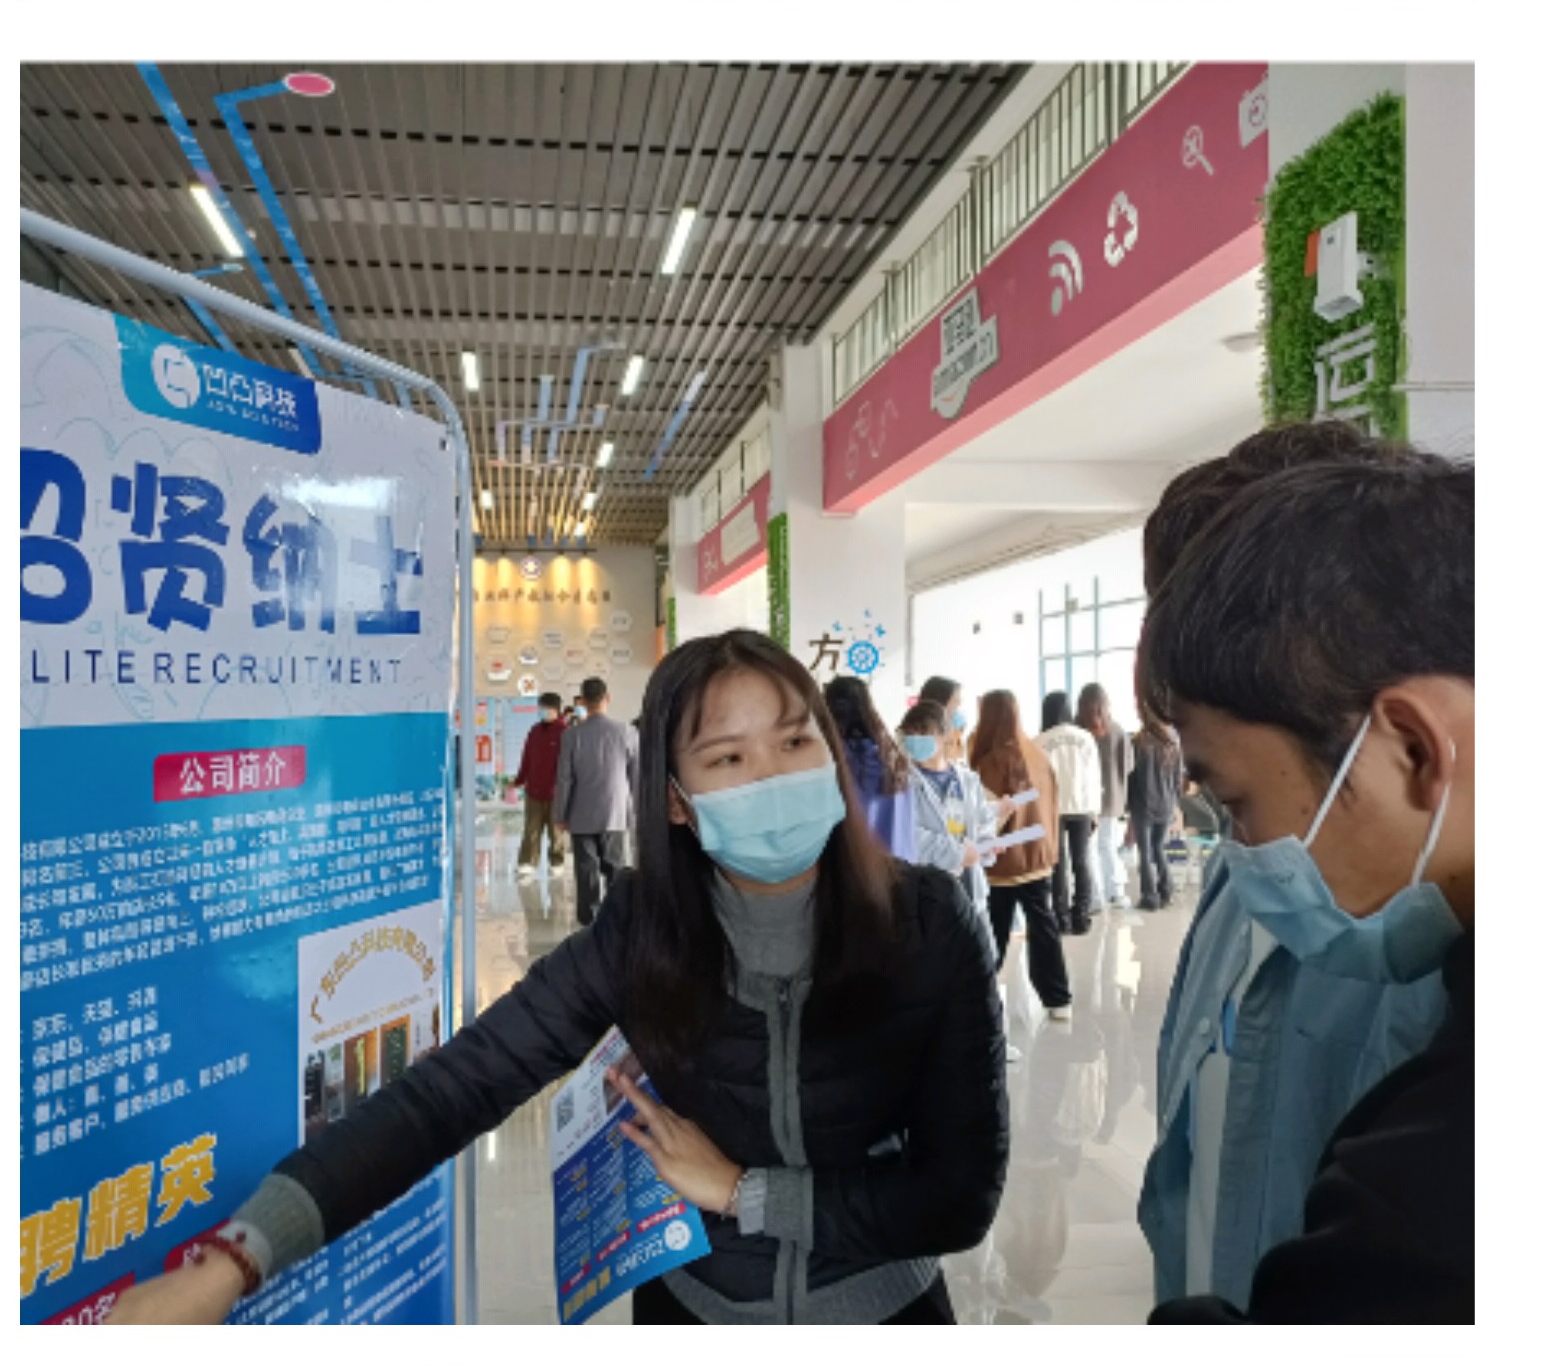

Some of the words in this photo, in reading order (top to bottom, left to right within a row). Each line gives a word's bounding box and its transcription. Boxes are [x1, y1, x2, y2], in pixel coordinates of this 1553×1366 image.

[31, 649, 136, 685] LITE
[152, 653, 404, 685] RECRUITMENT
[810, 634, 843, 672] 方
[178, 750, 287, 796] 公司简介
